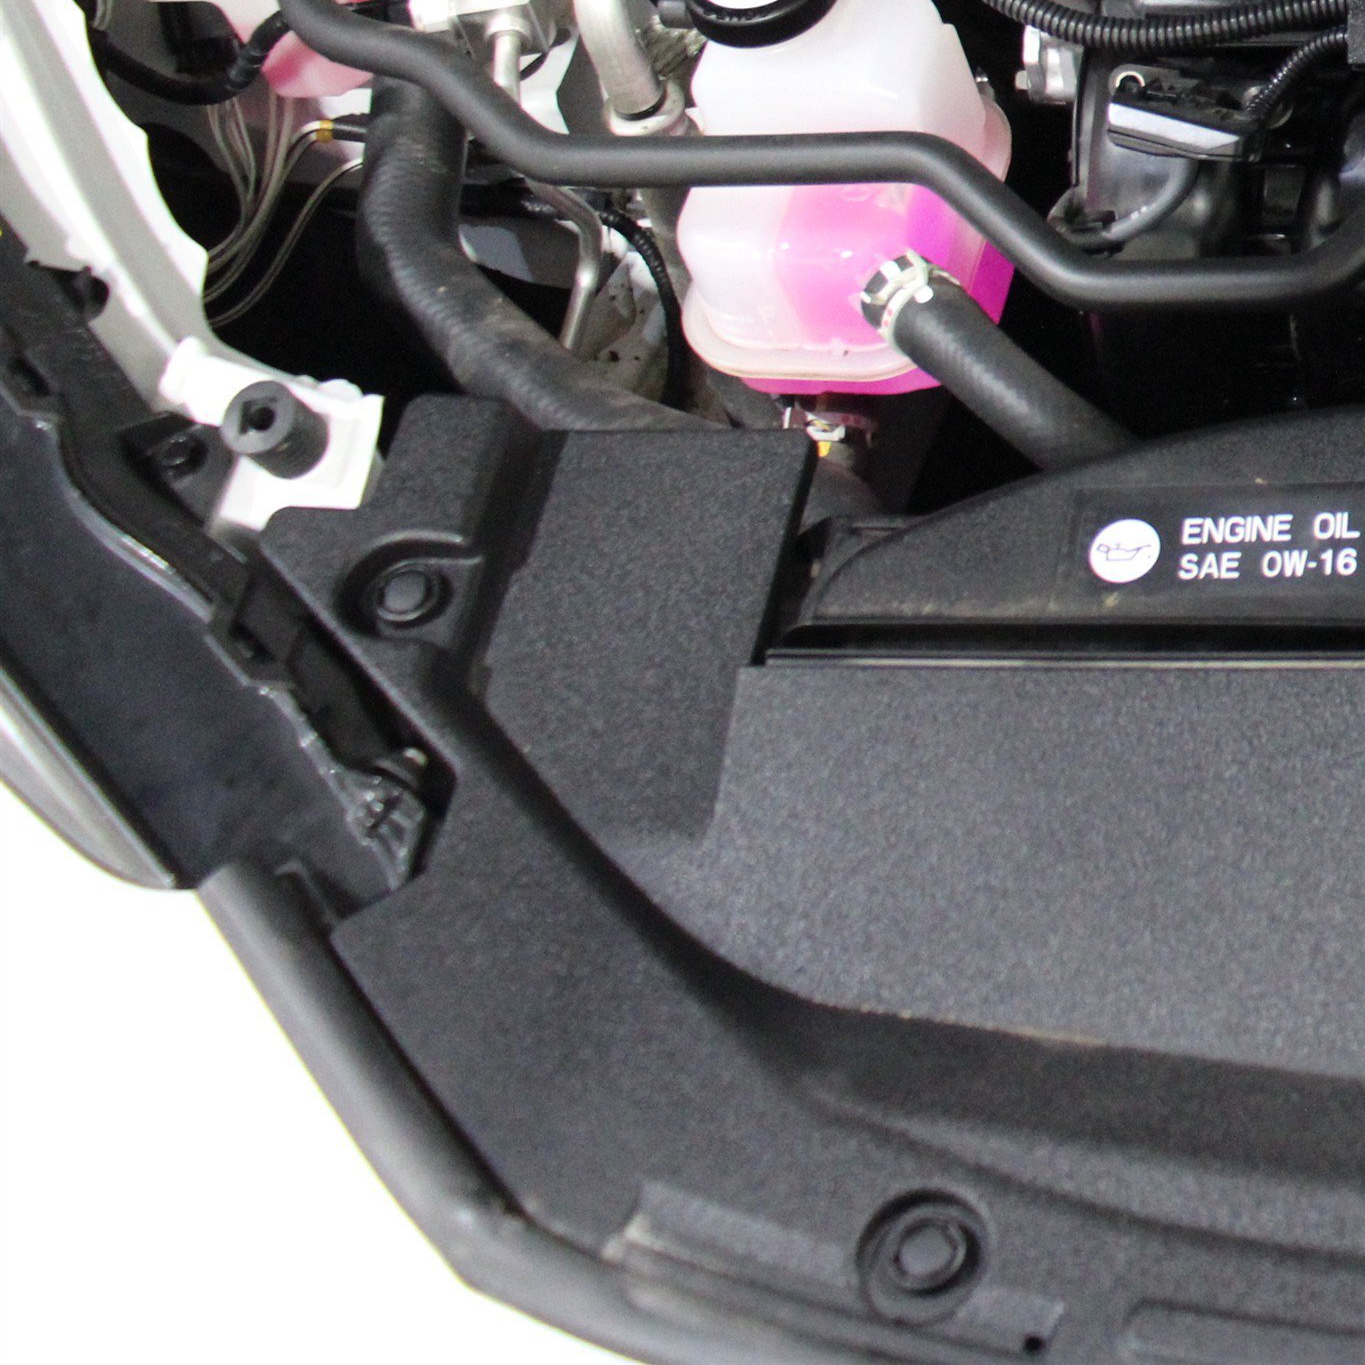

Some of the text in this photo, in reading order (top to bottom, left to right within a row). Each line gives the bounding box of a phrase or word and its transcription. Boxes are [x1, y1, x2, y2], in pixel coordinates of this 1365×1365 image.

[1182, 511, 1361, 545] ENGINE OIL
[1178, 547, 1358, 581] SAE 0W-16
